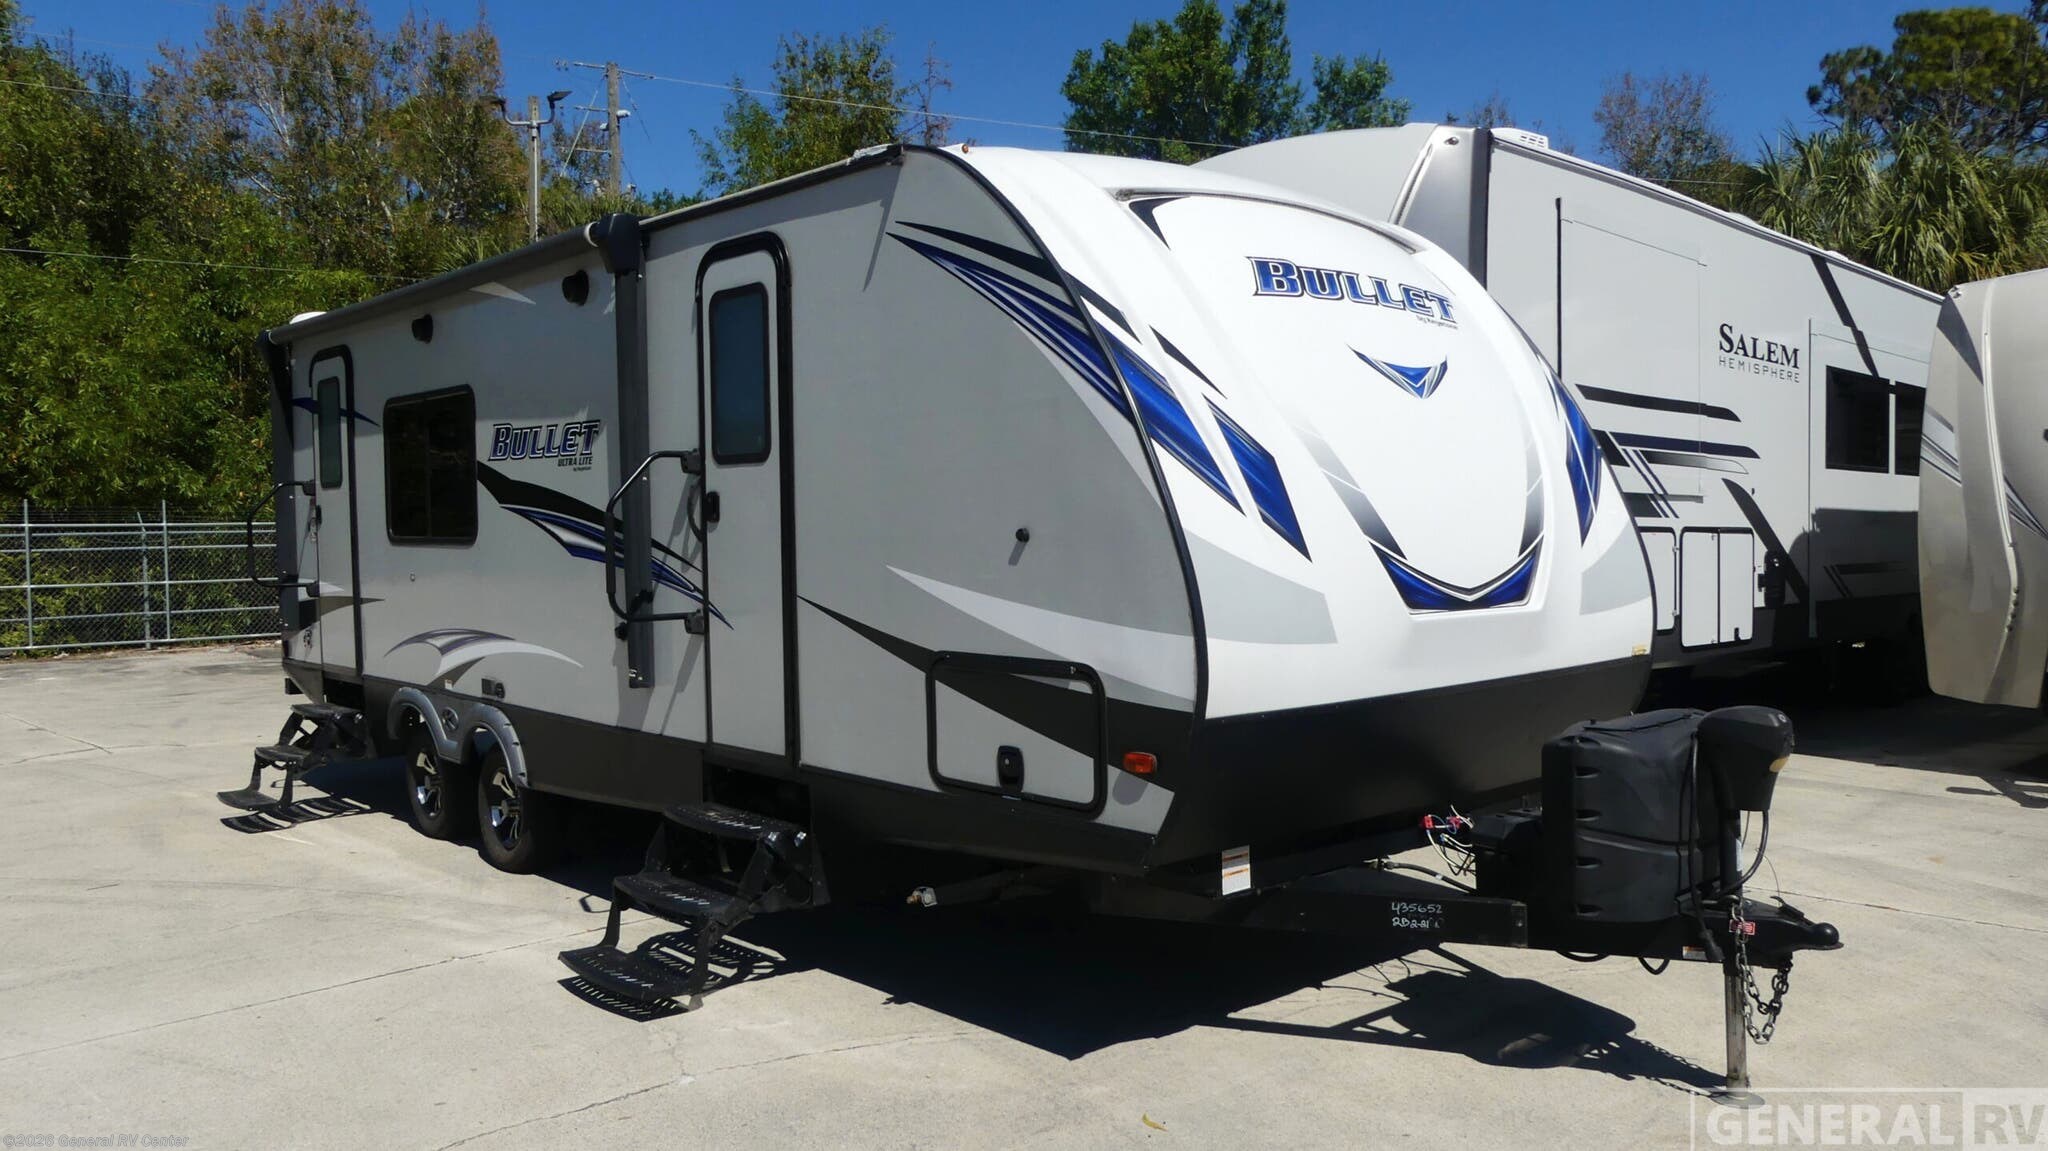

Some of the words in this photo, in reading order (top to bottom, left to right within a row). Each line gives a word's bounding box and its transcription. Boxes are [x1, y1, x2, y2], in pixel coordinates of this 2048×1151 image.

[1245, 256, 1457, 323] BULLET
[1719, 322, 1800, 369] SALEM
[1719, 355, 1800, 384] HEMISPHERE
[488, 419, 601, 461] BULLET
[557, 457, 577, 467] ULTRA
[578, 456, 593, 465] LITE
[1391, 901, 1443, 915] 435652
